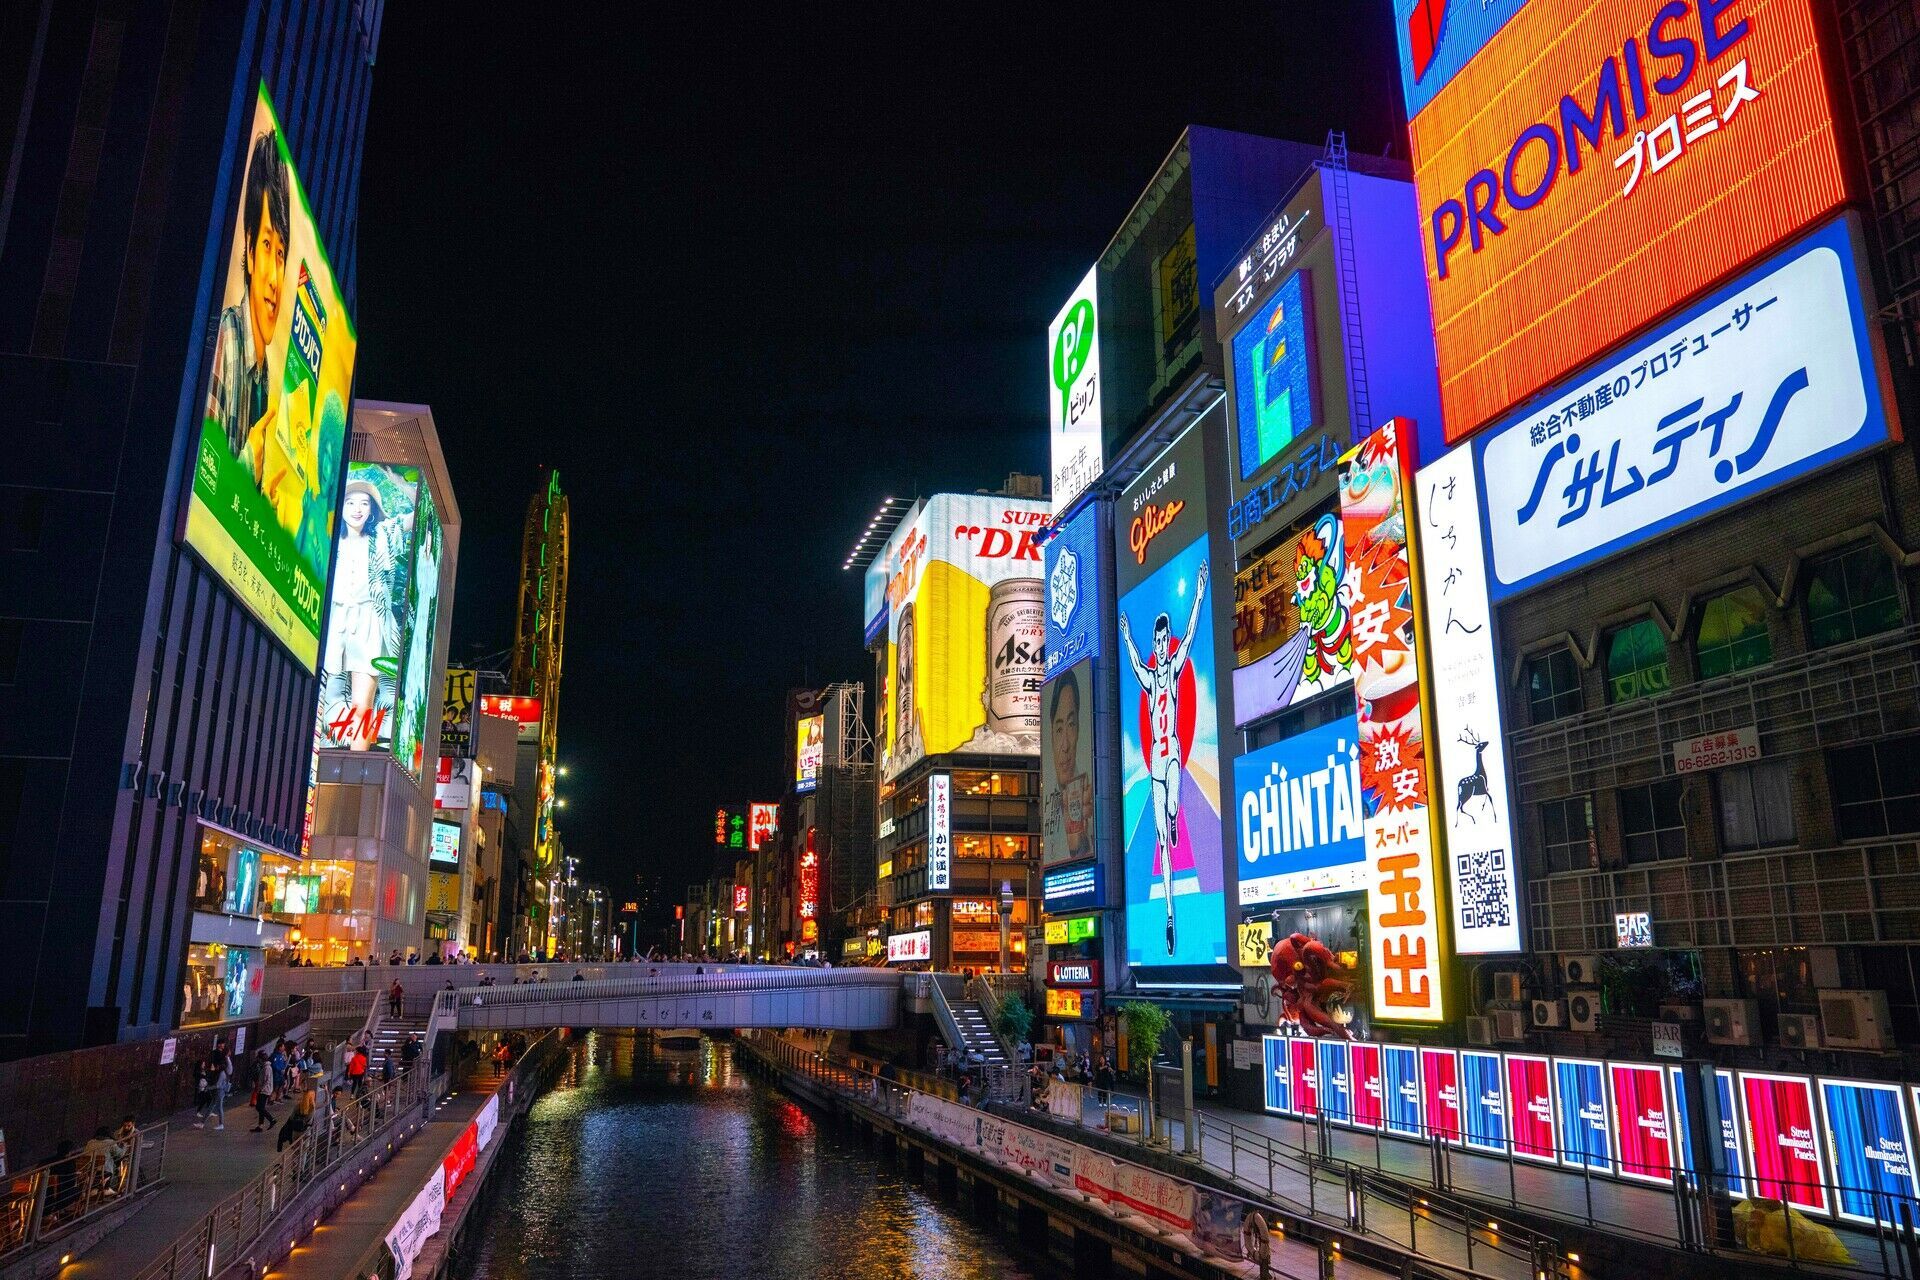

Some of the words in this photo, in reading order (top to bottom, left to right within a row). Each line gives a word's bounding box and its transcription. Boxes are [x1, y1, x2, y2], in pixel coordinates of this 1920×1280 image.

[1431, 0, 1750, 281] PROMISE
[1614, 57, 1761, 198] プロミス
[295, 303, 321, 382] サロンパス
[1529, 295, 1779, 449] 総合不動産のプロデューサー
[1070, 372, 1097, 426] ピップ
[1053, 445, 1087, 491] 令和元年
[1133, 461, 1176, 512] おいしさと健康
[1227, 433, 1344, 543] 日商エステム
[955, 525, 1052, 562] “DR
[1130, 500, 1185, 566] Glico
[292, 564, 321, 625] サロンパス
[327, 707, 388, 744] H&M
[1158, 688, 1170, 758] グリコ
[1691, 733, 1739, 754] 広告募集
[1374, 737, 1420, 804] 激安
[1677, 745, 1758, 771] 06-6262-1313
[936, 834, 948, 885] かに道楽
[1375, 821, 1420, 849] スーパー
[1376, 852, 1432, 1009] 玉出
[1616, 913, 1651, 936] BAR
[1060, 966, 1090, 980] LOTTERIA
[640, 1009, 714, 1021] えびす橋
[1654, 1025, 1680, 1041] BAR
